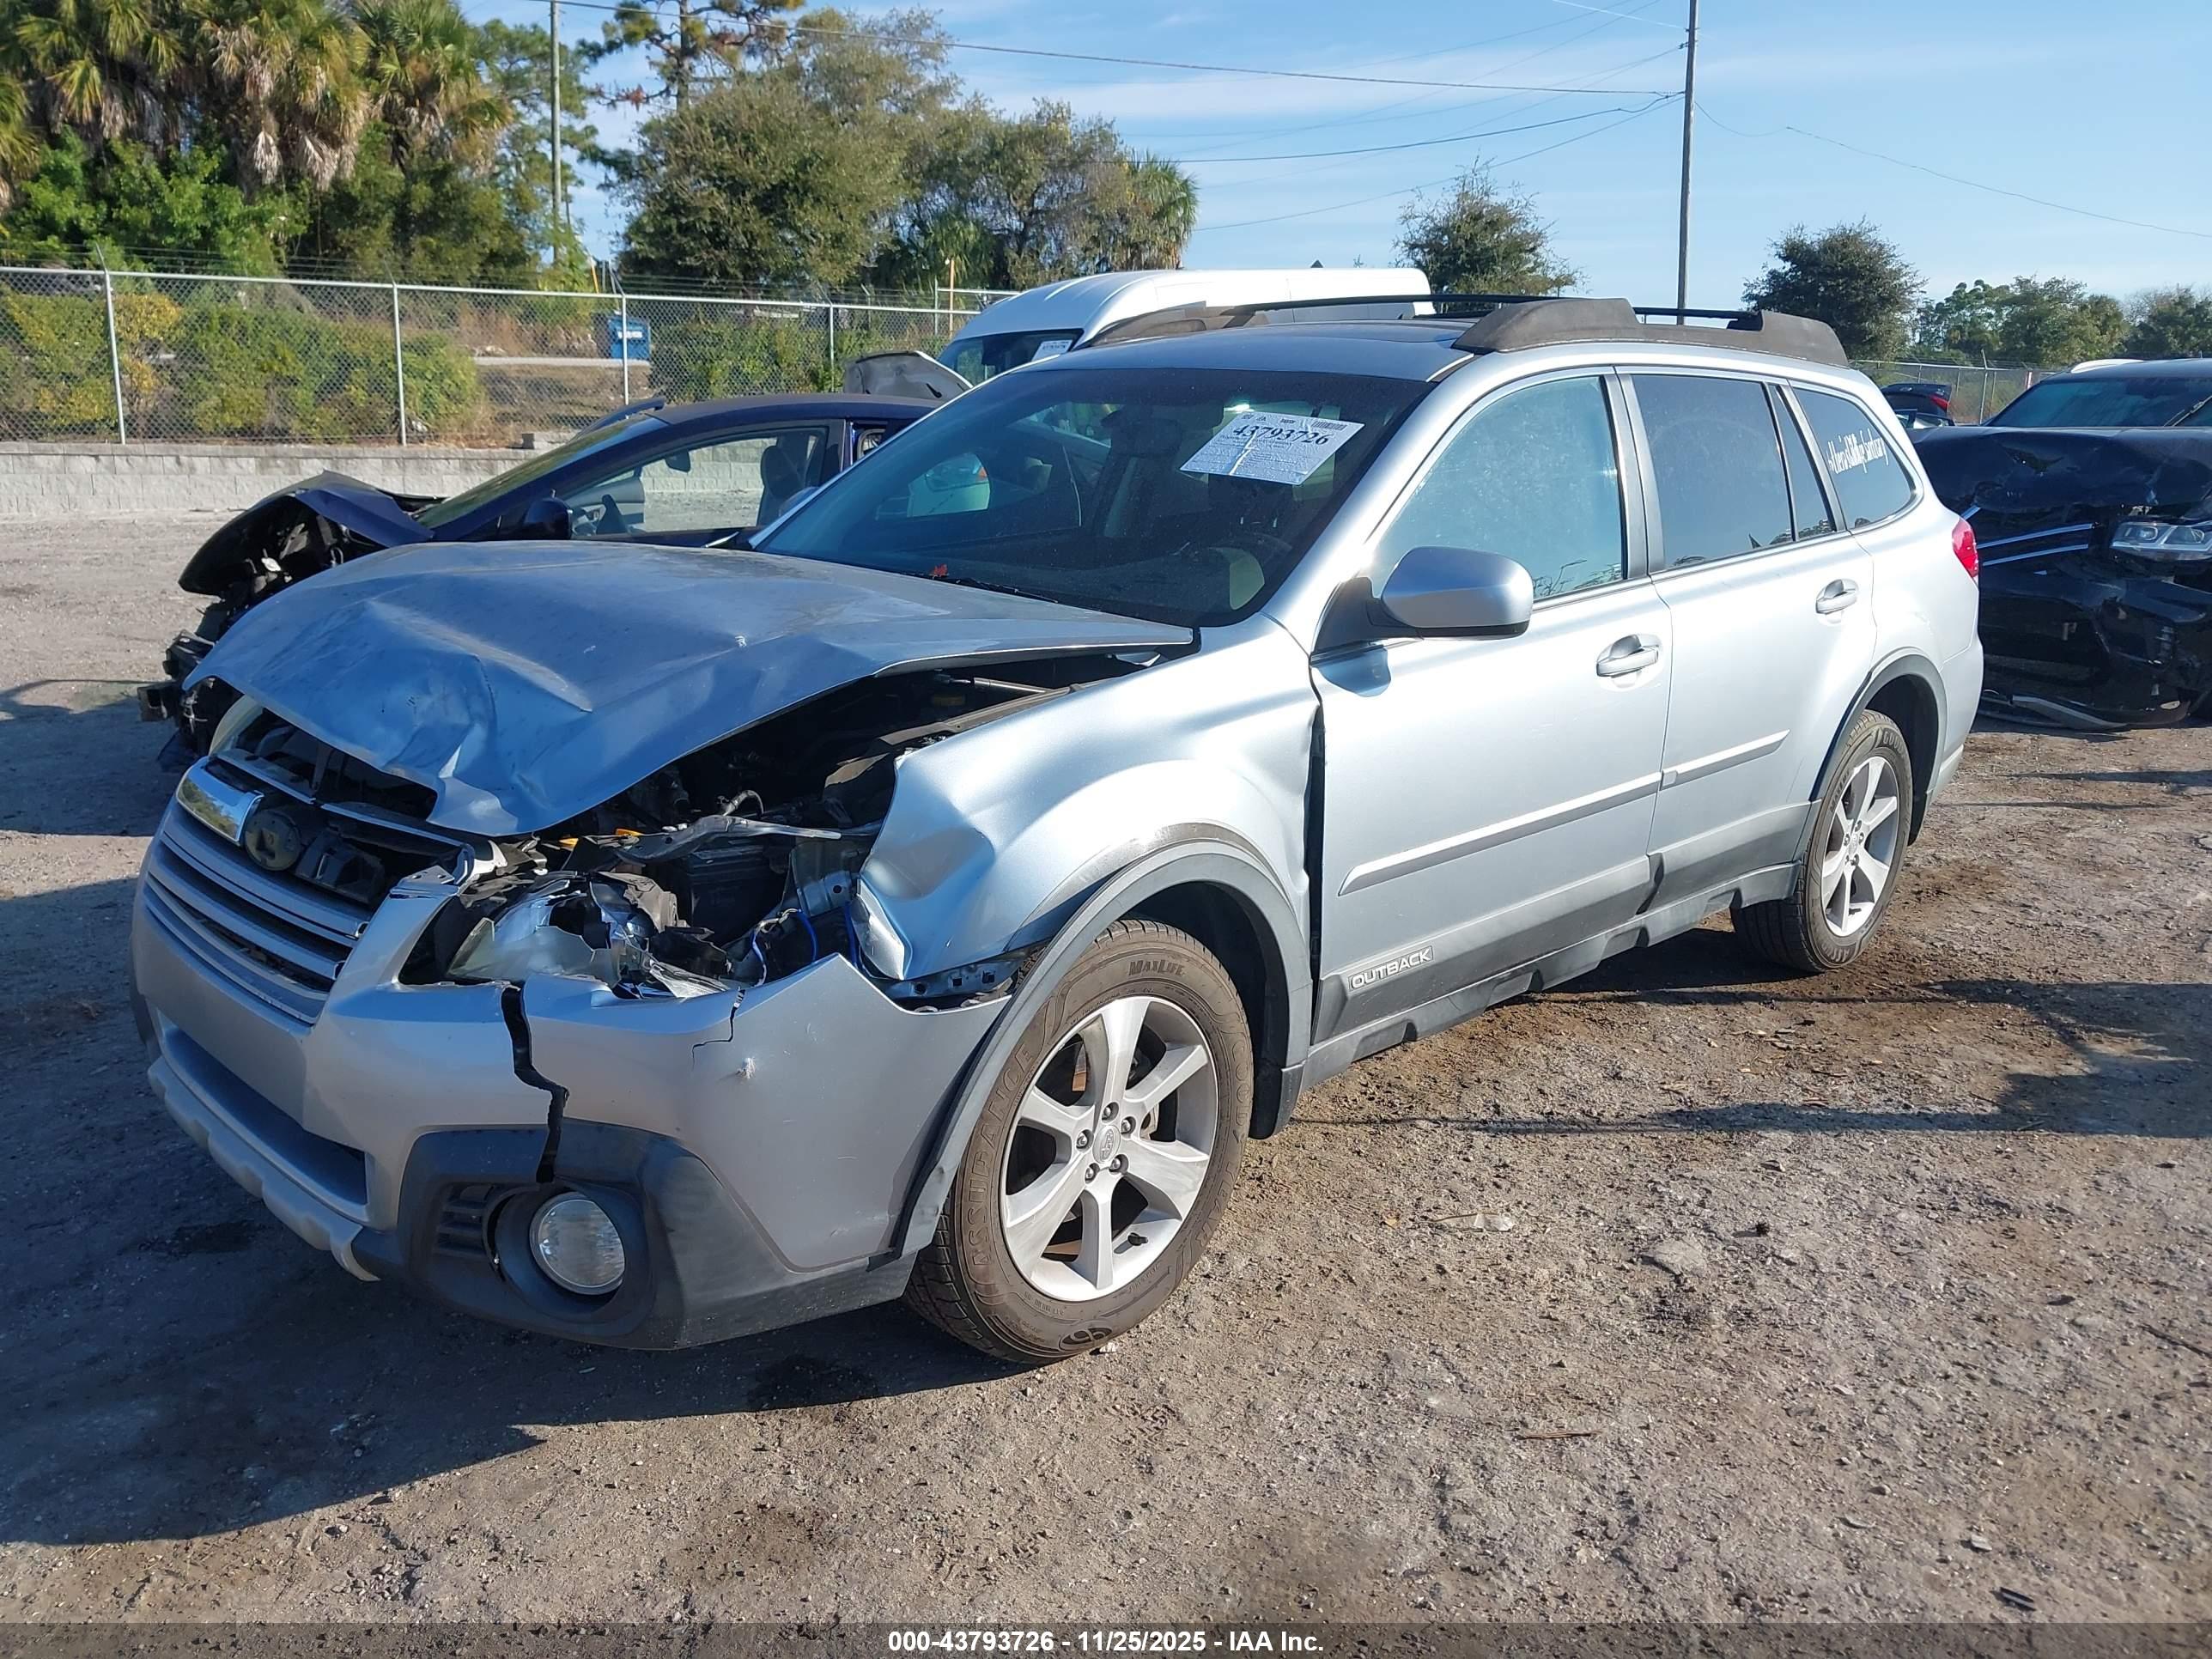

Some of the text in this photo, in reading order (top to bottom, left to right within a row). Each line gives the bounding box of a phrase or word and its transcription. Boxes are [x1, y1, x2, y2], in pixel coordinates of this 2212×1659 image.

[1233, 424, 1330, 445] 43793726
[1352, 948, 1431, 988] OUTBACK
[966, 1042, 1035, 1267] ASSURANCE
